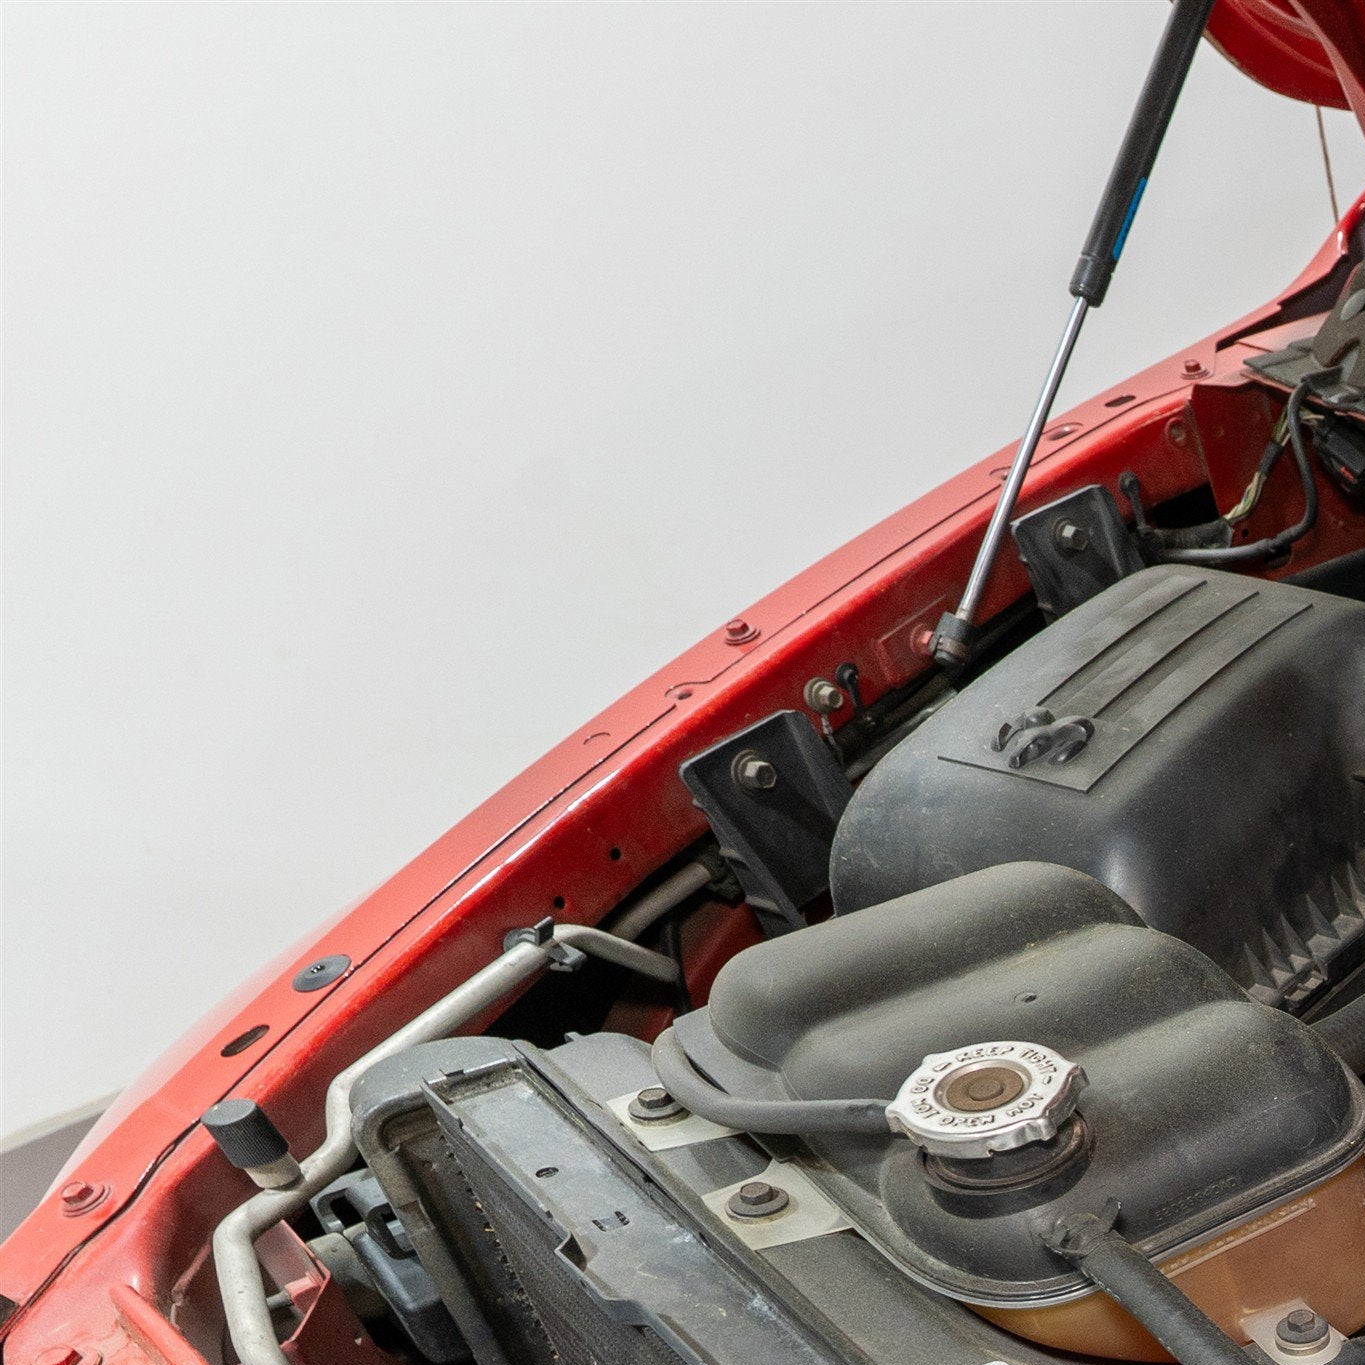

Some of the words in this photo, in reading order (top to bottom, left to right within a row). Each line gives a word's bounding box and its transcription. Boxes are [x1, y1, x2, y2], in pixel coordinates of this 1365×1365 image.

[956, 1046, 1015, 1063] KEEP
[1019, 1048, 1058, 1077] TIGHT
[938, 1114, 996, 1127] OPEN
